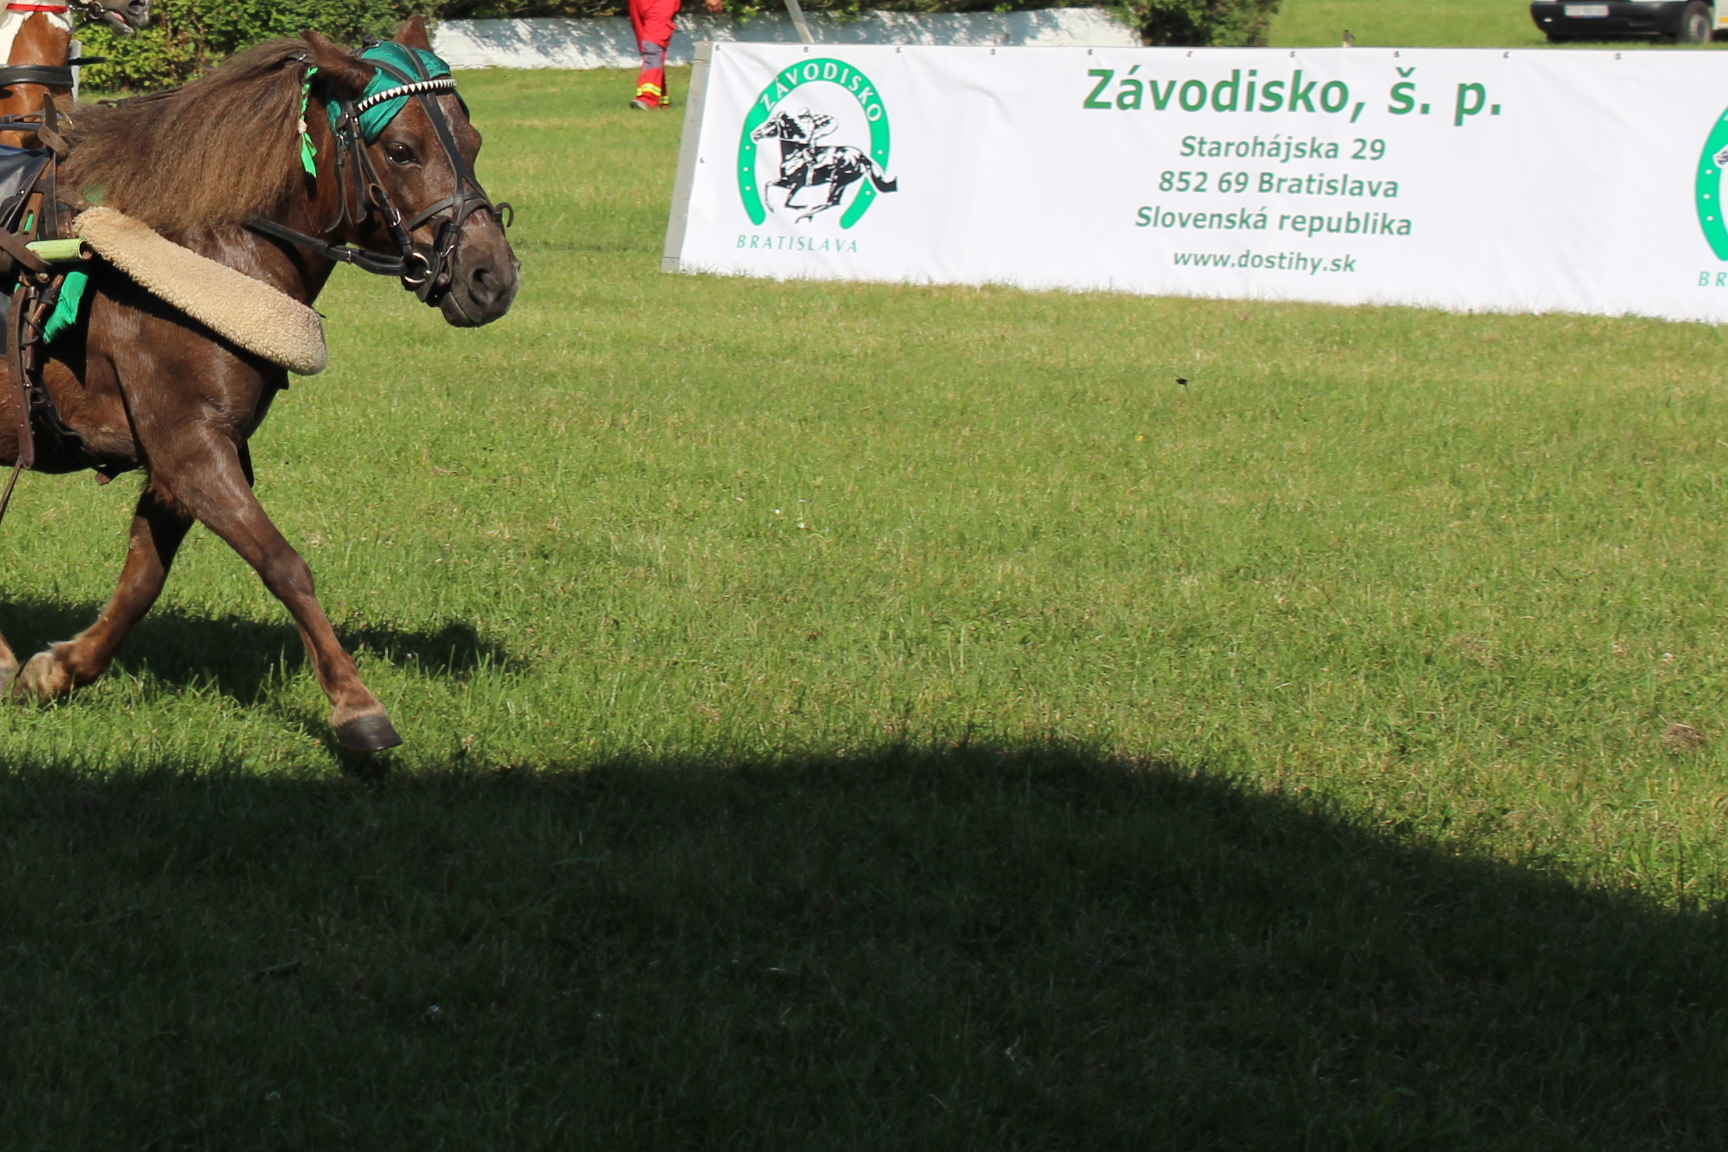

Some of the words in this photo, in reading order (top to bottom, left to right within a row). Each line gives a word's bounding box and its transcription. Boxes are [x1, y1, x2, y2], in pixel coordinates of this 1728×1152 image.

[759, 62, 883, 122] ZÁVODISKO
[1083, 64, 1367, 124] Závodisko,
[1387, 67, 1432, 116] š.
[1453, 80, 1503, 127] p.
[1179, 134, 1340, 163] Starohájska
[1350, 137, 1387, 161] 29
[1158, 170, 1209, 193] 852
[1217, 171, 1250, 194] 69
[1257, 171, 1400, 198] Bratislava
[1135, 205, 1269, 230] Slovenská
[1278, 211, 1413, 238] republika
[736, 234, 858, 253] BRATISLAVA
[1173, 249, 1357, 276] www.dostihy.sk
